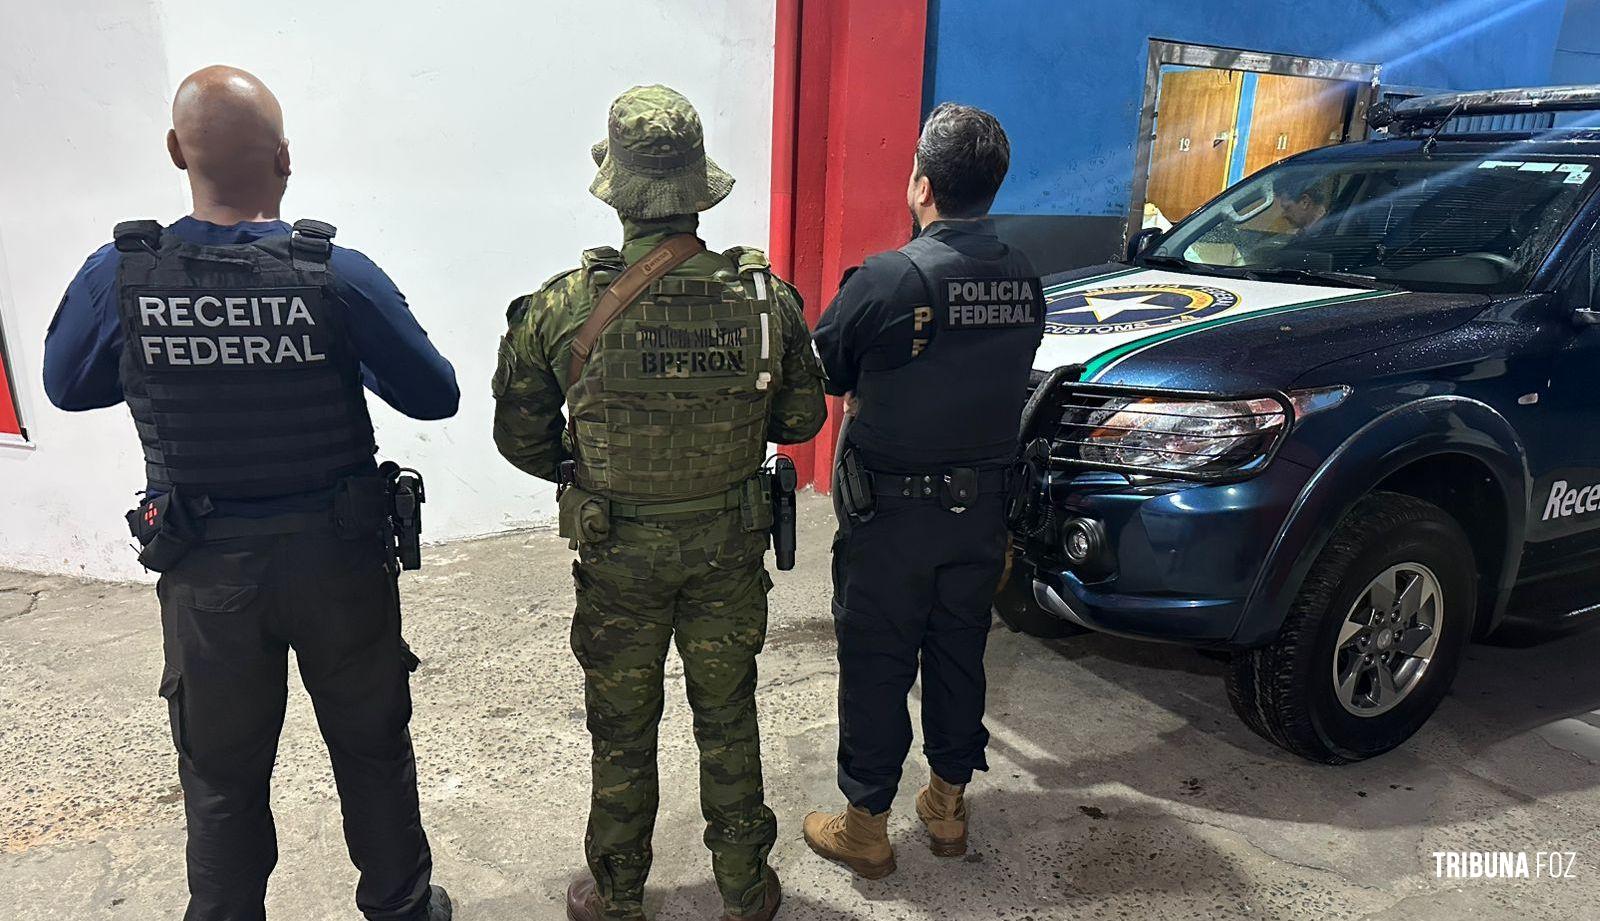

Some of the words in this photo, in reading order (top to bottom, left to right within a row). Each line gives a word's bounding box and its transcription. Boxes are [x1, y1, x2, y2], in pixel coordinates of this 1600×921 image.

[1276, 134, 1288, 150] 11
[138, 295, 316, 328] RECEITA
[948, 304, 1035, 326] FEDERAL
[1044, 322, 1151, 335] CUSTOMS
[140, 334, 326, 366] FEDERAL
[641, 350, 746, 373] BPFRON
[1541, 480, 1600, 521] Rece
